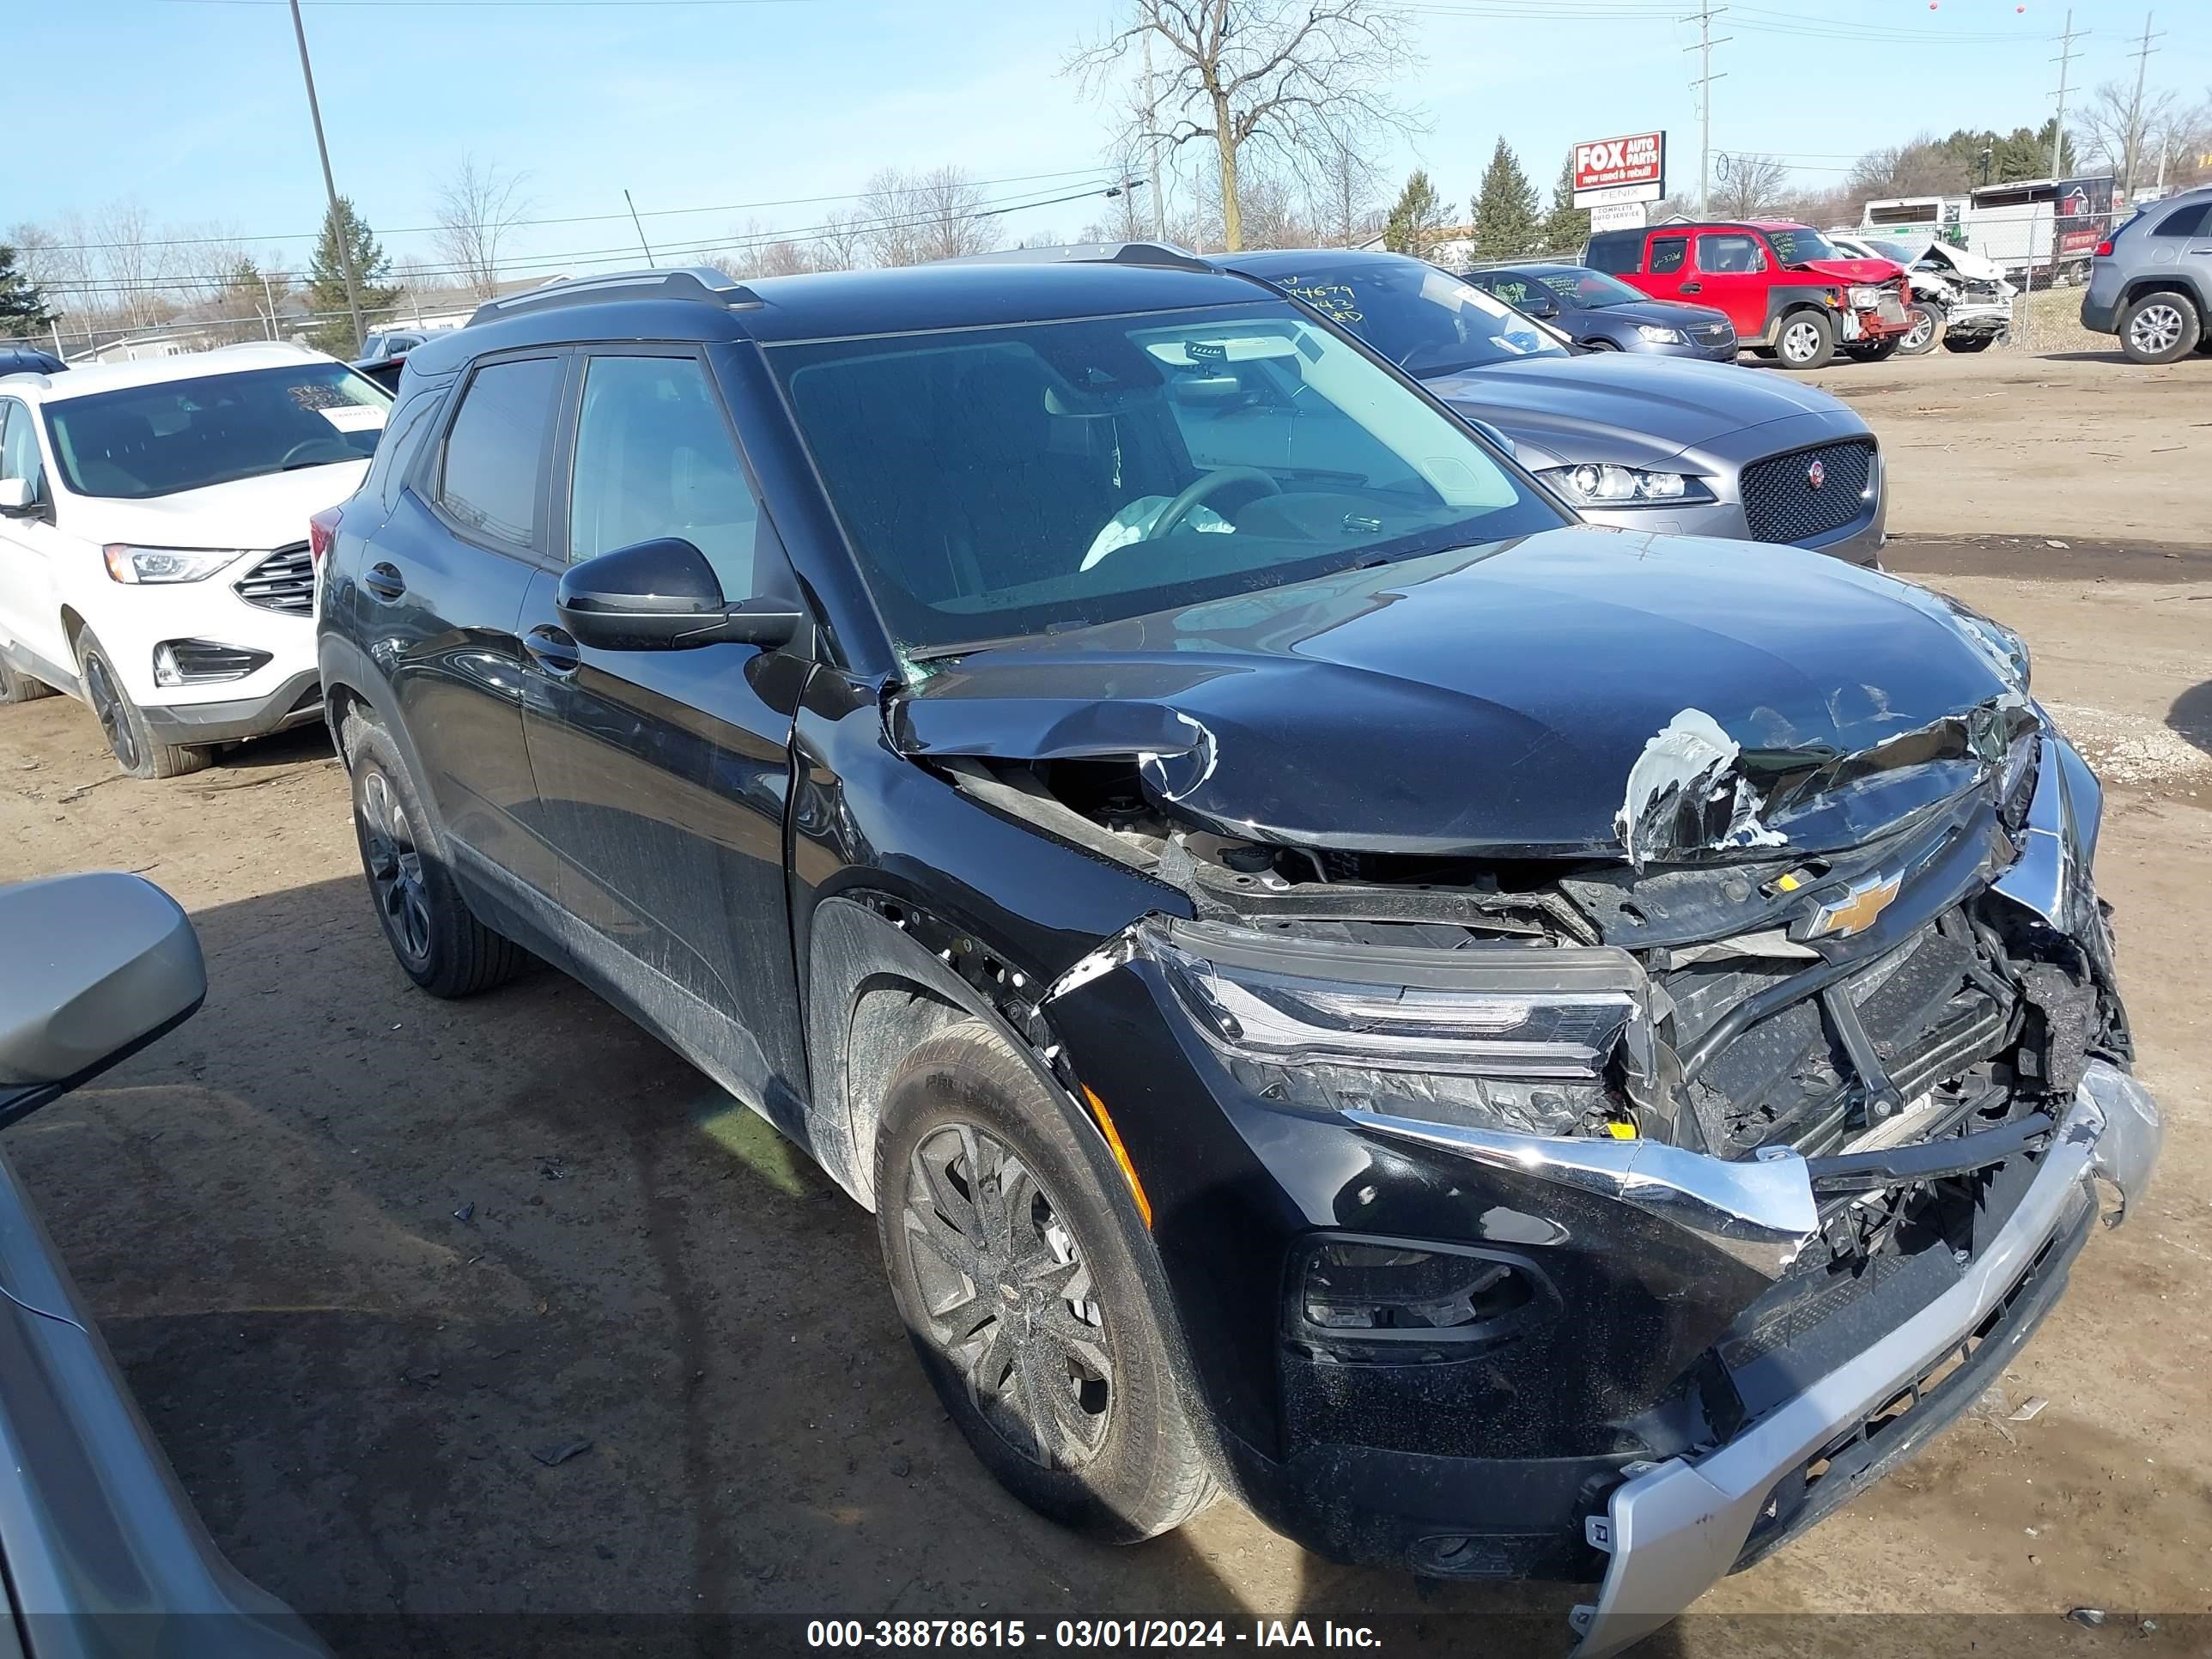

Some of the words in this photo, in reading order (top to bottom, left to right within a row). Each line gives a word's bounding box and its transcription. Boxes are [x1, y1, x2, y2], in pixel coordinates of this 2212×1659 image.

[1626, 137, 1655, 154] AUTO
[1578, 141, 1626, 173] FOX
[1626, 150, 1658, 167] PARTS
[1600, 171, 1619, 181] used
[1627, 166, 1652, 178] rebuilt
[1601, 187, 1639, 200] FENIX
[1613, 210, 1639, 219] SERVICE
